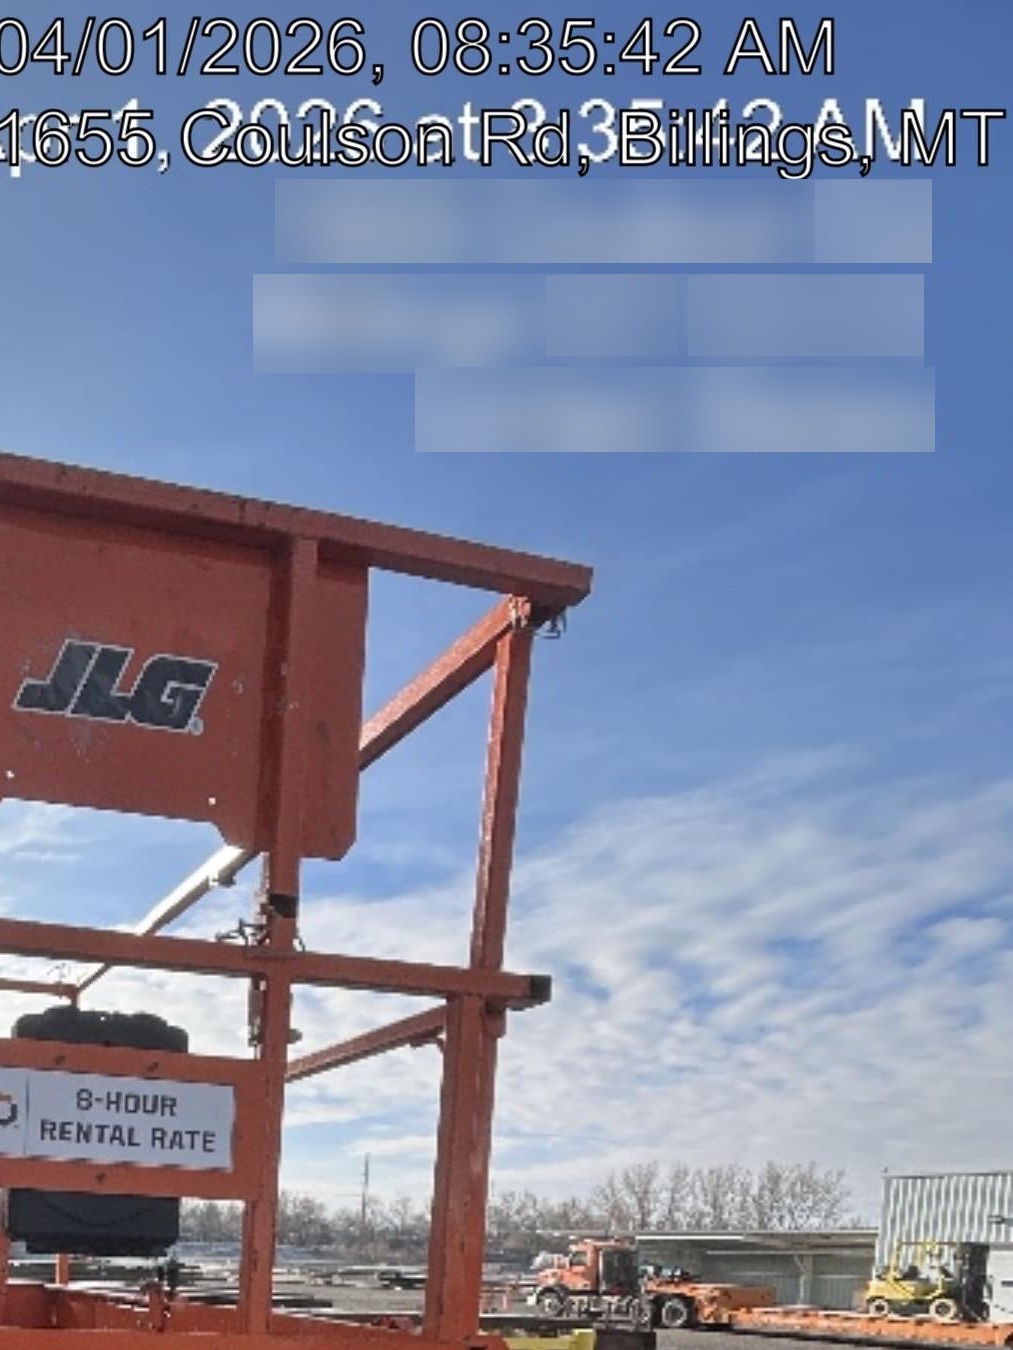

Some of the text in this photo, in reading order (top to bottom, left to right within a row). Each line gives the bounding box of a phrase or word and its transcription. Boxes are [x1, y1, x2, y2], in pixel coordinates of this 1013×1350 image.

[12, 638, 219, 733] JLG
[75, 1088, 178, 1117] 8-HOUR
[39, 1118, 217, 1152] RENTAL RATE
